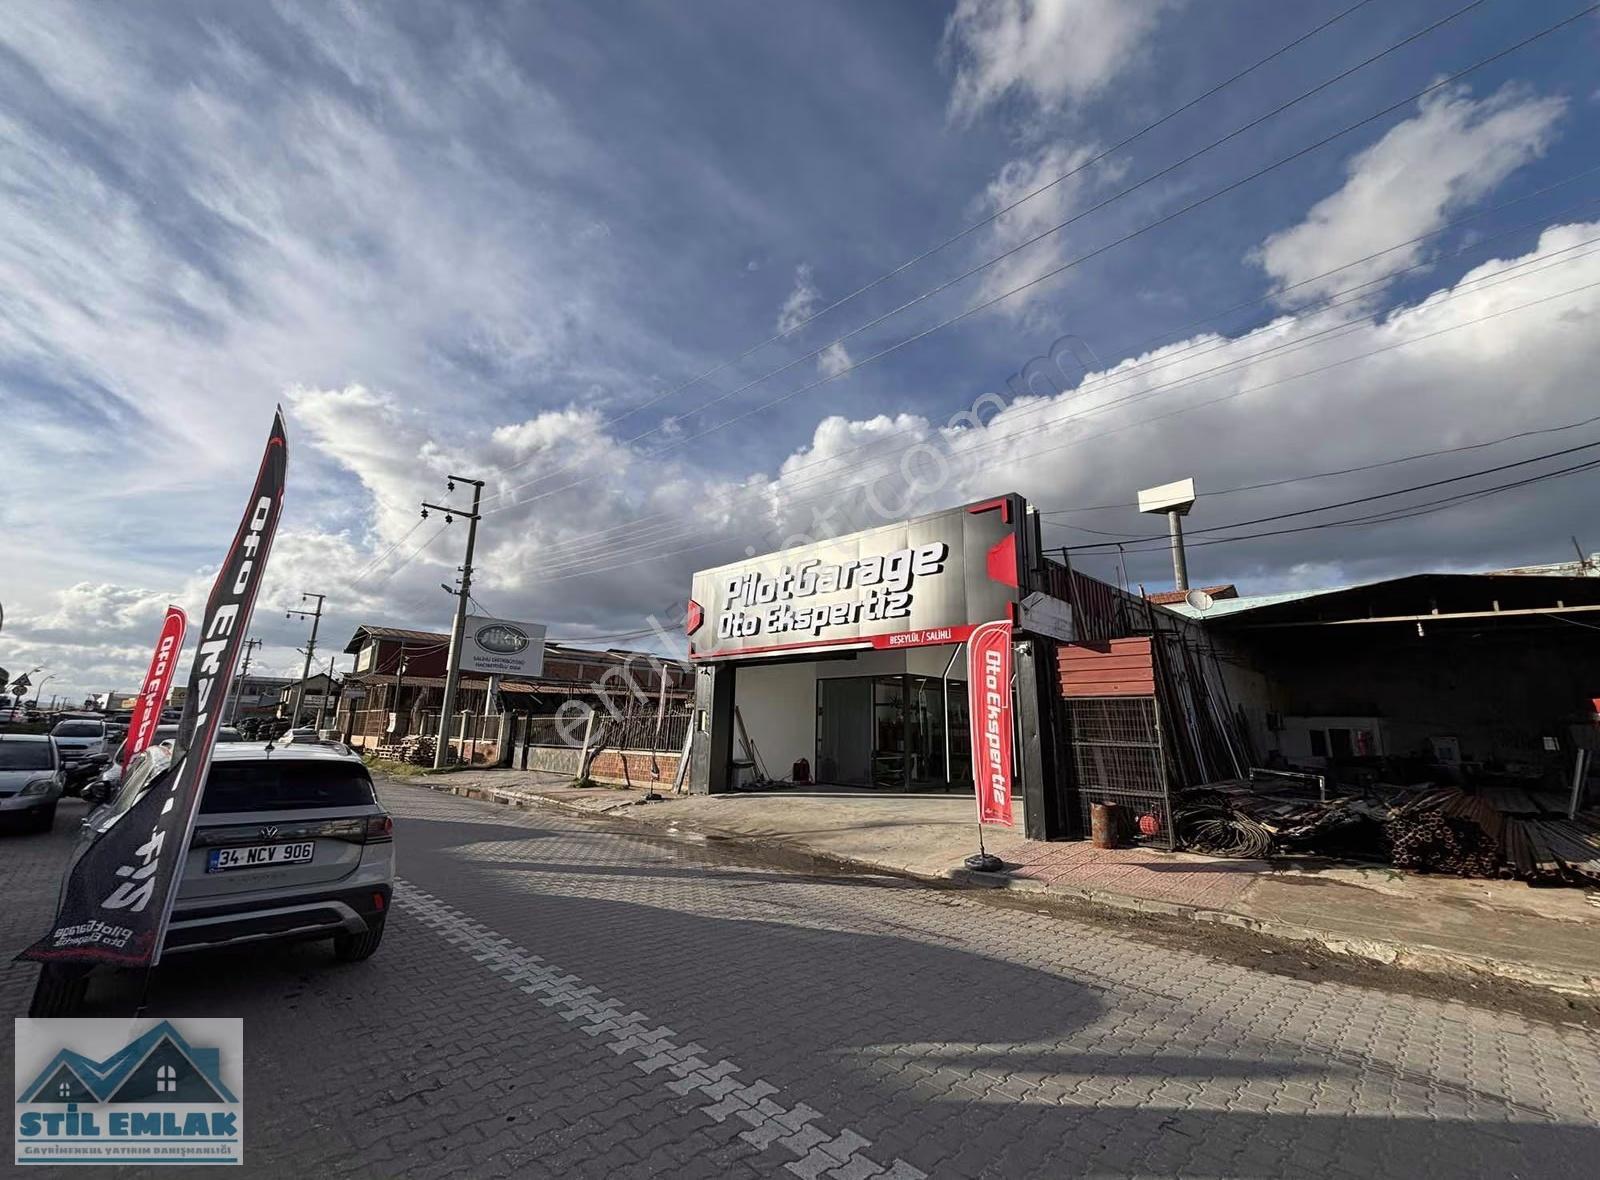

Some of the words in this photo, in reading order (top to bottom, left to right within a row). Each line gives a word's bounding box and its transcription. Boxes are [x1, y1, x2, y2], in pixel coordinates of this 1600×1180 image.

[724, 541, 949, 610] PilotGarage
[717, 612, 760, 639] Oto
[764, 587, 913, 636] Ekspertiz
[926, 629, 952, 642] SALİHLİ
[985, 650, 1001, 688] Oto
[985, 693, 1006, 806] Ekspertiz
[219, 849, 239, 866] 34
[246, 846, 278, 863] NCV
[283, 844, 312, 860] 906
